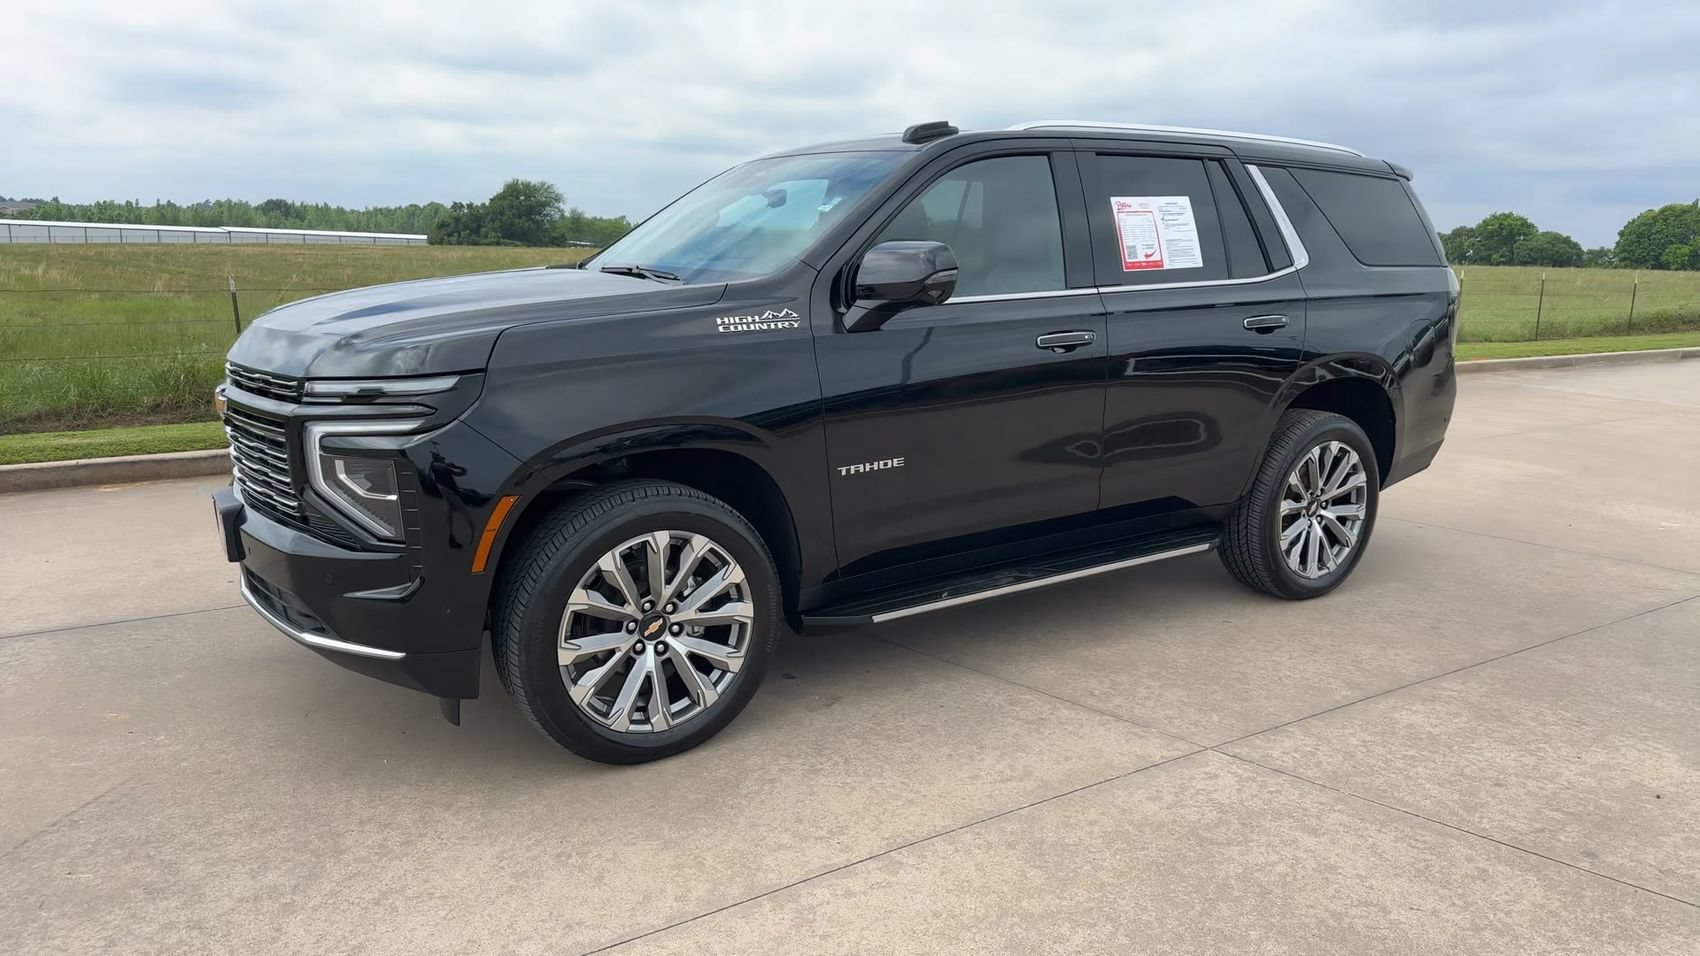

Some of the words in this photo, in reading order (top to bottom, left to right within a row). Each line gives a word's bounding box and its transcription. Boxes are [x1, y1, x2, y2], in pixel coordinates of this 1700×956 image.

[716, 315, 759, 325] HIGH
[717, 320, 801, 333] COUNTRY
[837, 457, 905, 477] TAHOE
